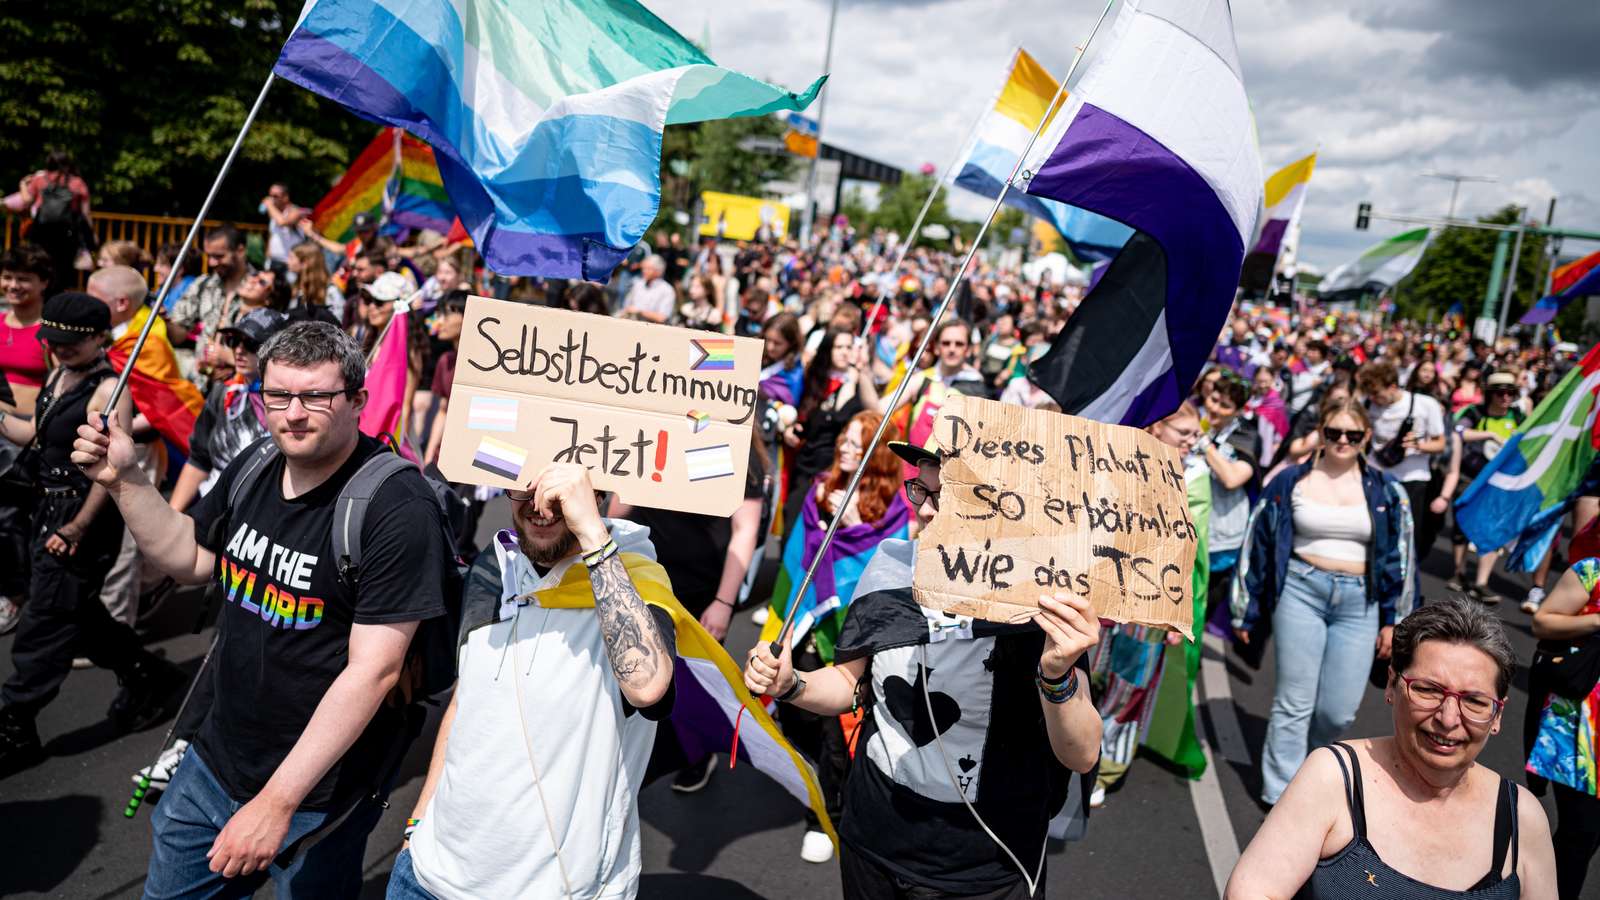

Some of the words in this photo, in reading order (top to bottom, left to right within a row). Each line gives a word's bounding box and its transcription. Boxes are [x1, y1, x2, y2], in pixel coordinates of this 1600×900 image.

[467, 316, 757, 425] Selbstbestimmung
[550, 416, 668, 482] Jetzt!
[943, 414, 1046, 465] Dieses
[1043, 491, 1198, 543] erbärmlich
[226, 522, 269, 568] AM
[268, 543, 318, 591] THE
[1034, 556, 1091, 596] das
[1092, 544, 1184, 605] TSG
